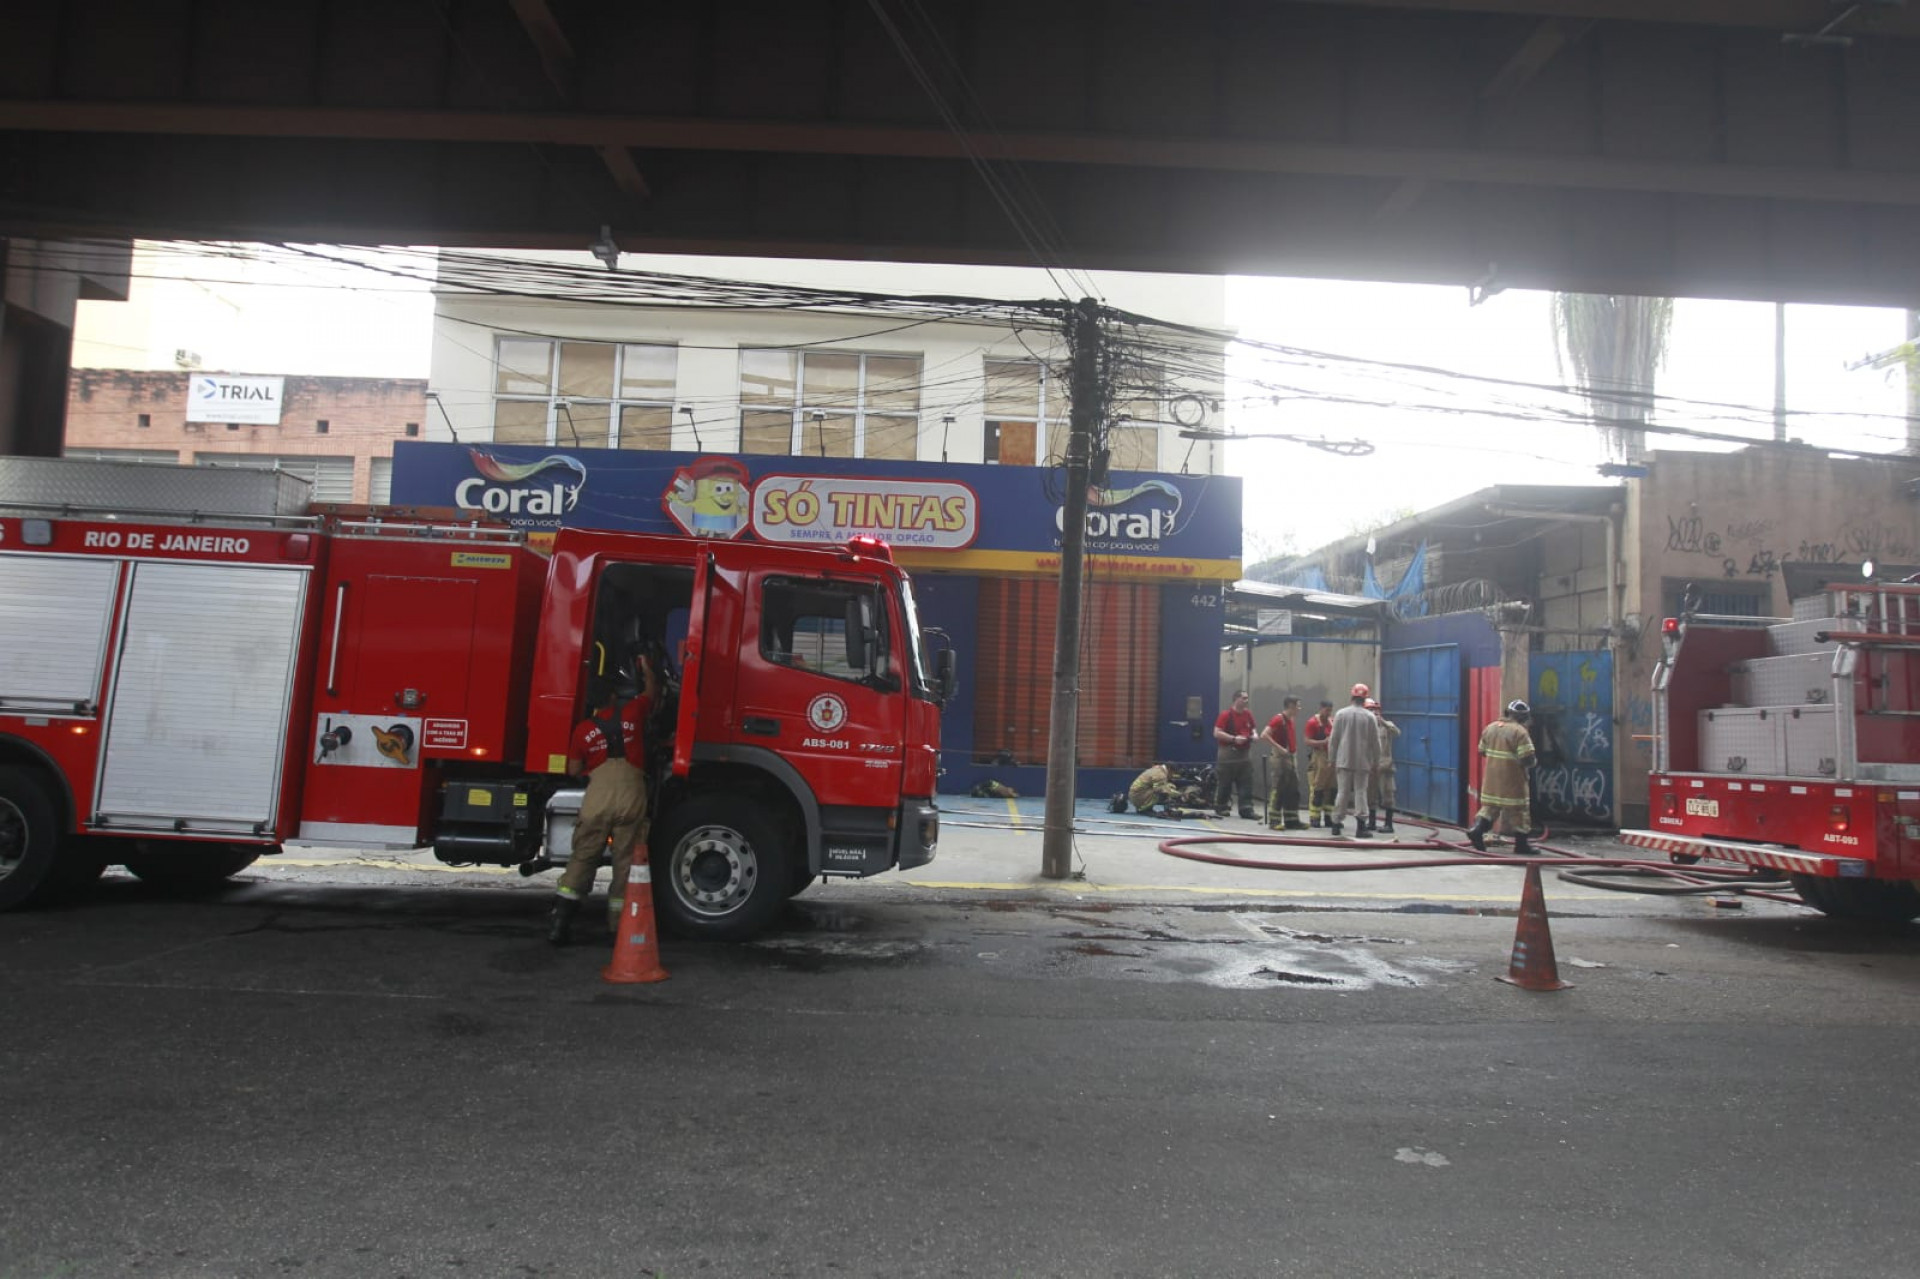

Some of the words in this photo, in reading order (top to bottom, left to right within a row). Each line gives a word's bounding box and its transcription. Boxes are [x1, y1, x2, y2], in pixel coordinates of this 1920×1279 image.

[219, 385, 275, 401] TRIAL
[455, 478, 564, 515] Coral
[763, 480, 820, 526] SÓ
[829, 492, 966, 531] TINTAS
[1055, 504, 1161, 540] oral
[84, 531, 121, 548] RIO
[126, 533, 155, 549] DE
[159, 534, 250, 553] JANEIRO
[790, 529, 831, 540] SEMPRE
[835, 531, 844, 540] A
[1191, 595, 1217, 607] 442
[803, 739, 849, 750] ABS-081
